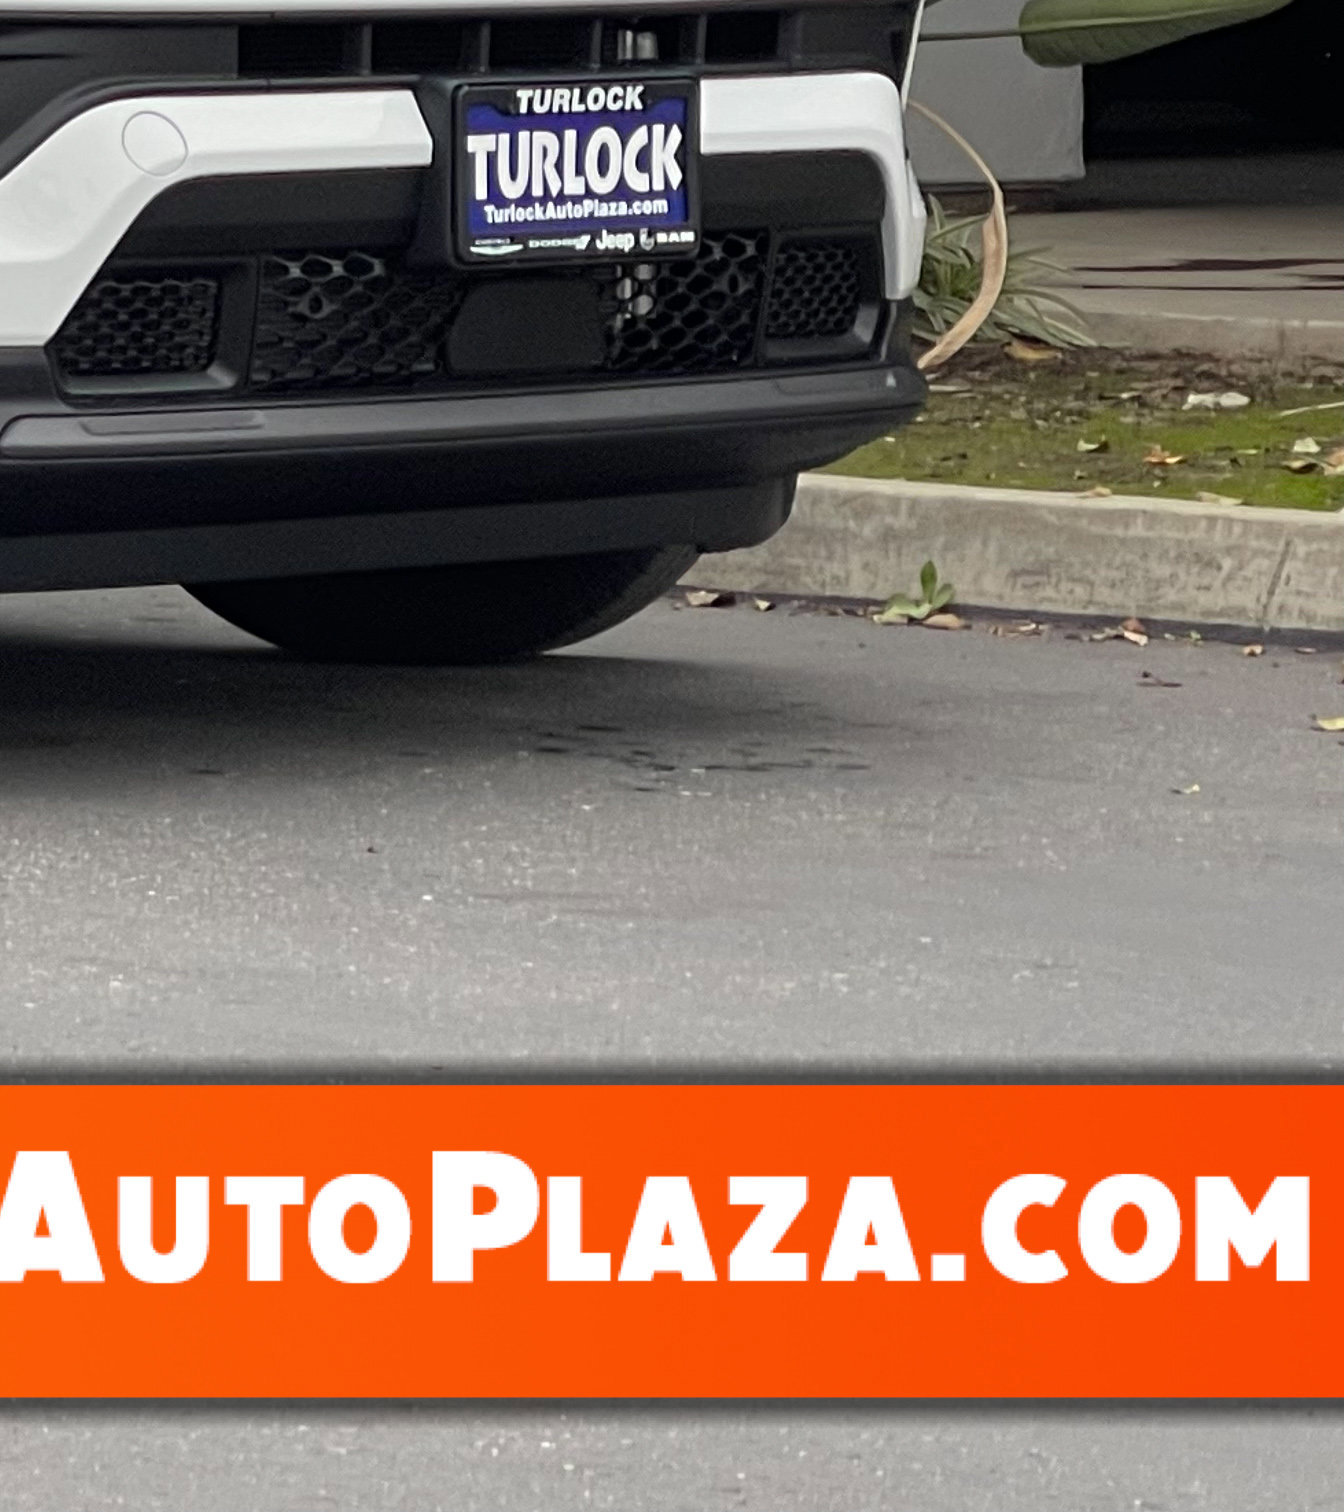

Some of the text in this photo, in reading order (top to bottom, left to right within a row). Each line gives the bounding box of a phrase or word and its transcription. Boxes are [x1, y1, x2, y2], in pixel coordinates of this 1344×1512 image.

[516, 85, 645, 114] TURLOCK
[467, 123, 683, 201] TURLOCK
[484, 199, 668, 224] TurlockAutoPlaza.com
[595, 228, 635, 253] Jeep
